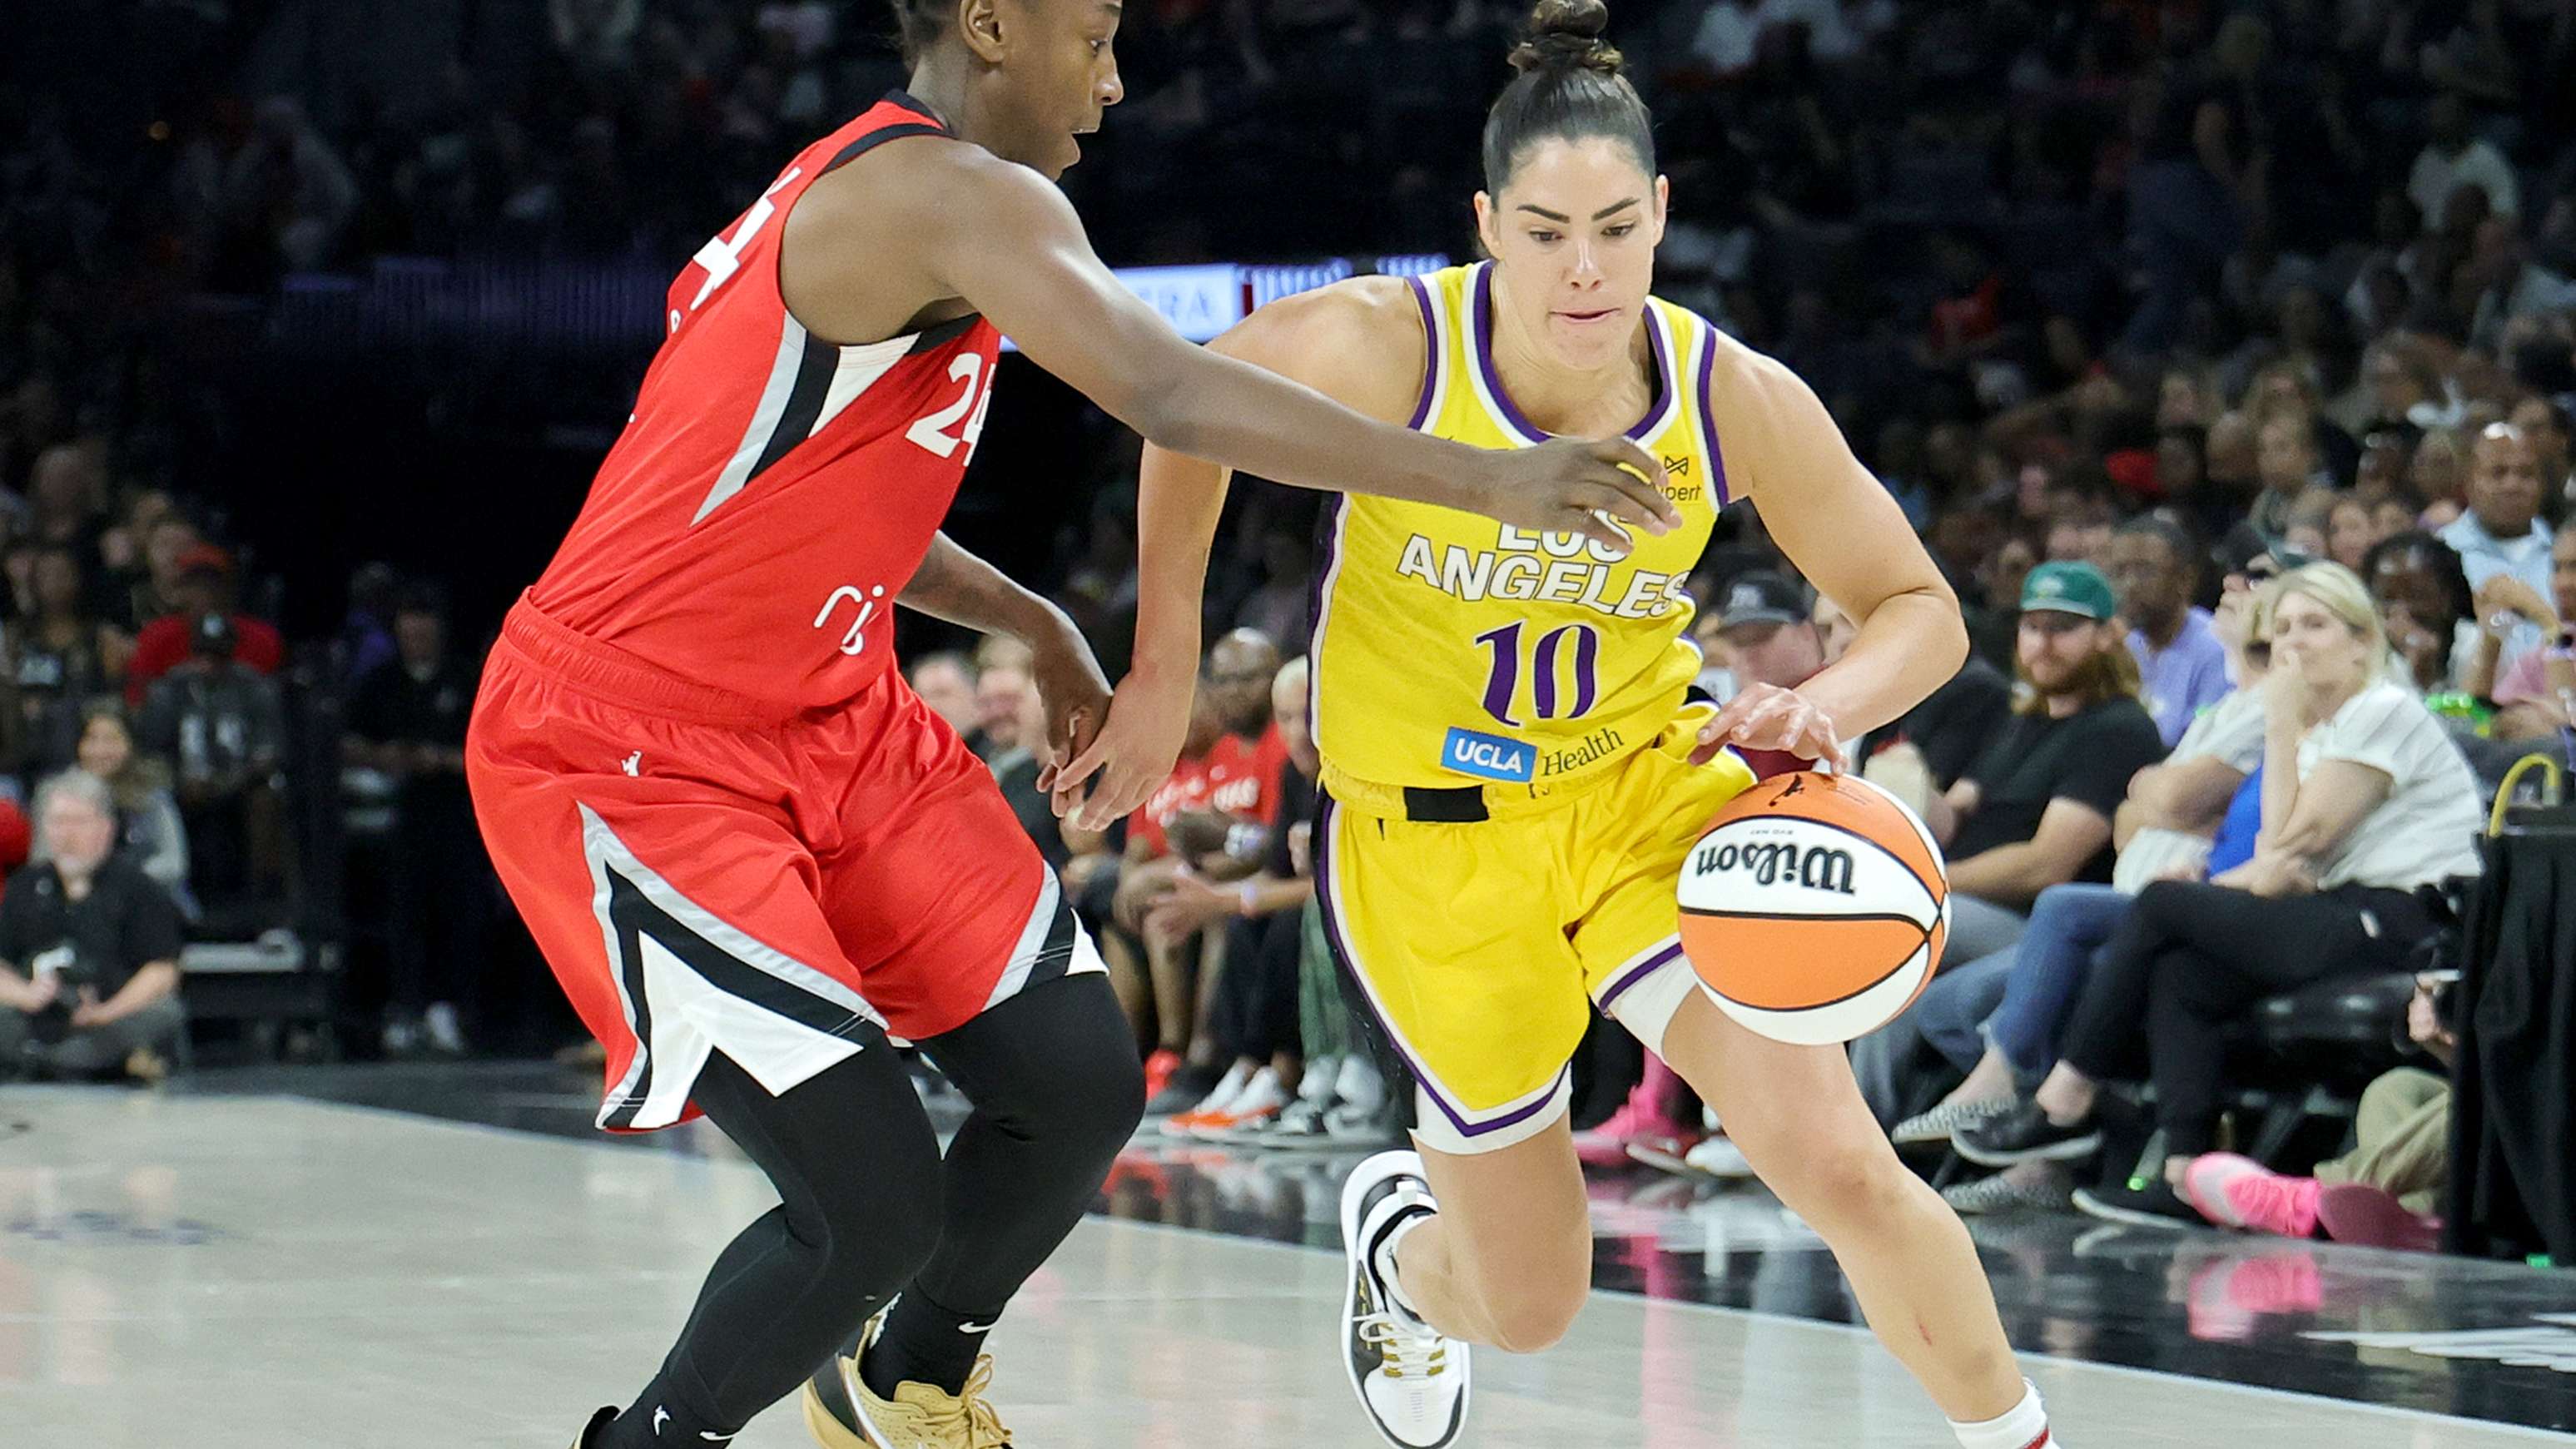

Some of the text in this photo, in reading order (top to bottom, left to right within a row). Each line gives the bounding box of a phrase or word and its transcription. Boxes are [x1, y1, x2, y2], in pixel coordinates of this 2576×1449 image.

[905, 353, 996, 466] 24
[1660, 484, 1701, 501] pert
[1396, 533, 1690, 619] ANGELES
[1474, 618, 1601, 728] 10
[1454, 727, 1624, 777] UCLA Health
[1695, 842, 1855, 895] Wilson
